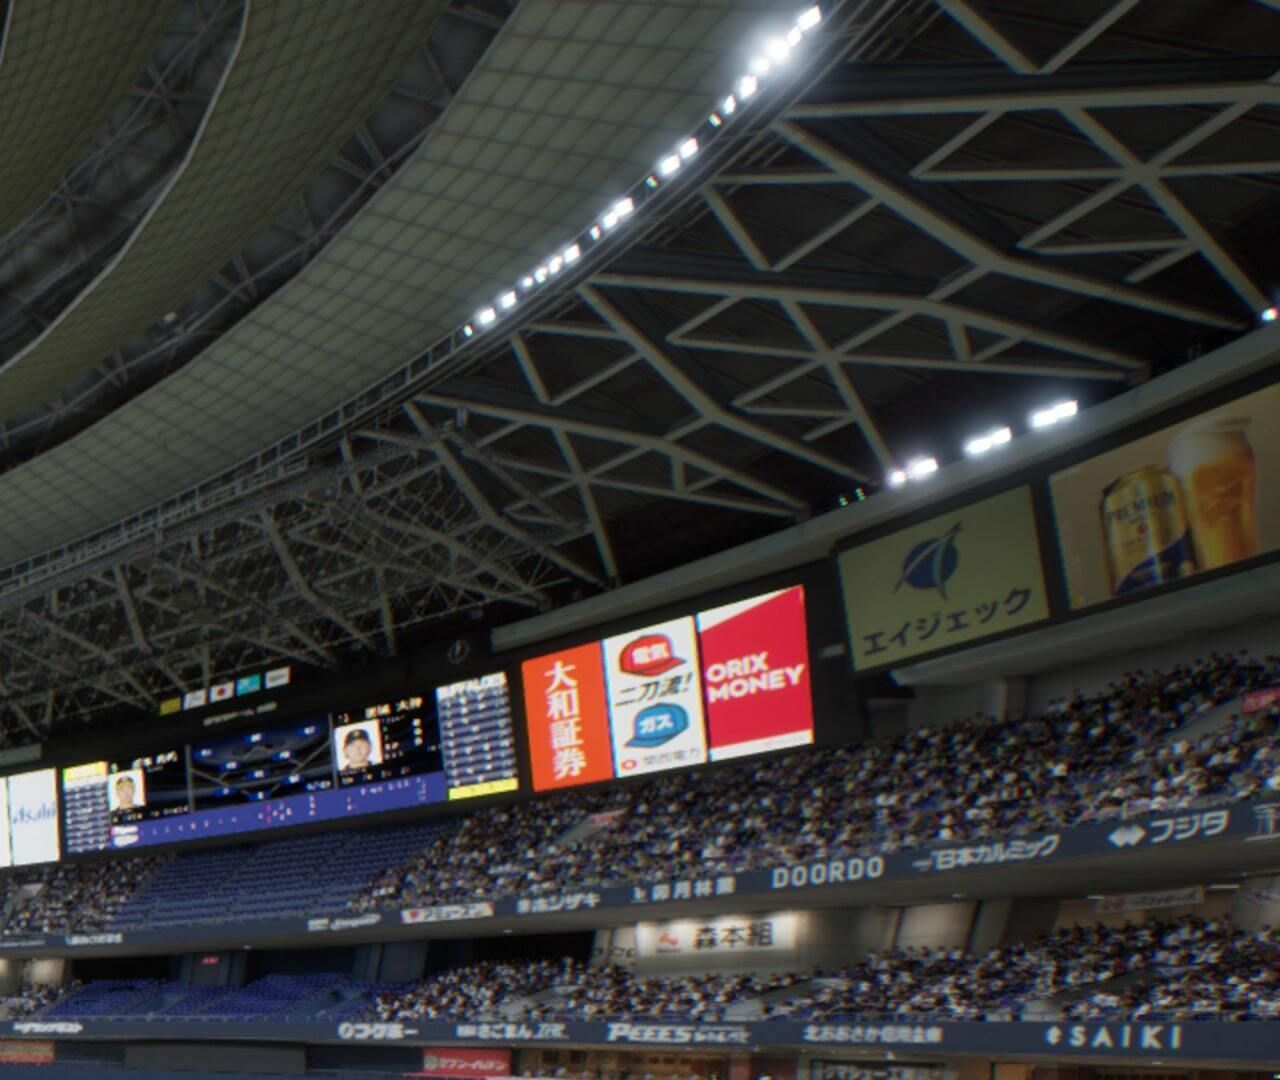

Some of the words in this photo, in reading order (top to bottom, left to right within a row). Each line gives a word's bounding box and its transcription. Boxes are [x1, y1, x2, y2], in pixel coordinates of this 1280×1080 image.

[862, 587, 1031, 657] エイジェック
[632, 642, 670, 664] 電気
[706, 651, 769, 682] ORIX
[707, 664, 805, 703] MONEY
[544, 660, 587, 781] 大和証券
[639, 713, 674, 734] ガス
[13, 801, 58, 825] Asahi
[1150, 809, 1229, 843] フジタ
[935, 833, 1060, 870] 日本カルミック
[771, 856, 885, 889] DOORDO
[693, 921, 773, 949] 森本組
[1068, 1025, 1183, 1050] SAIKI
